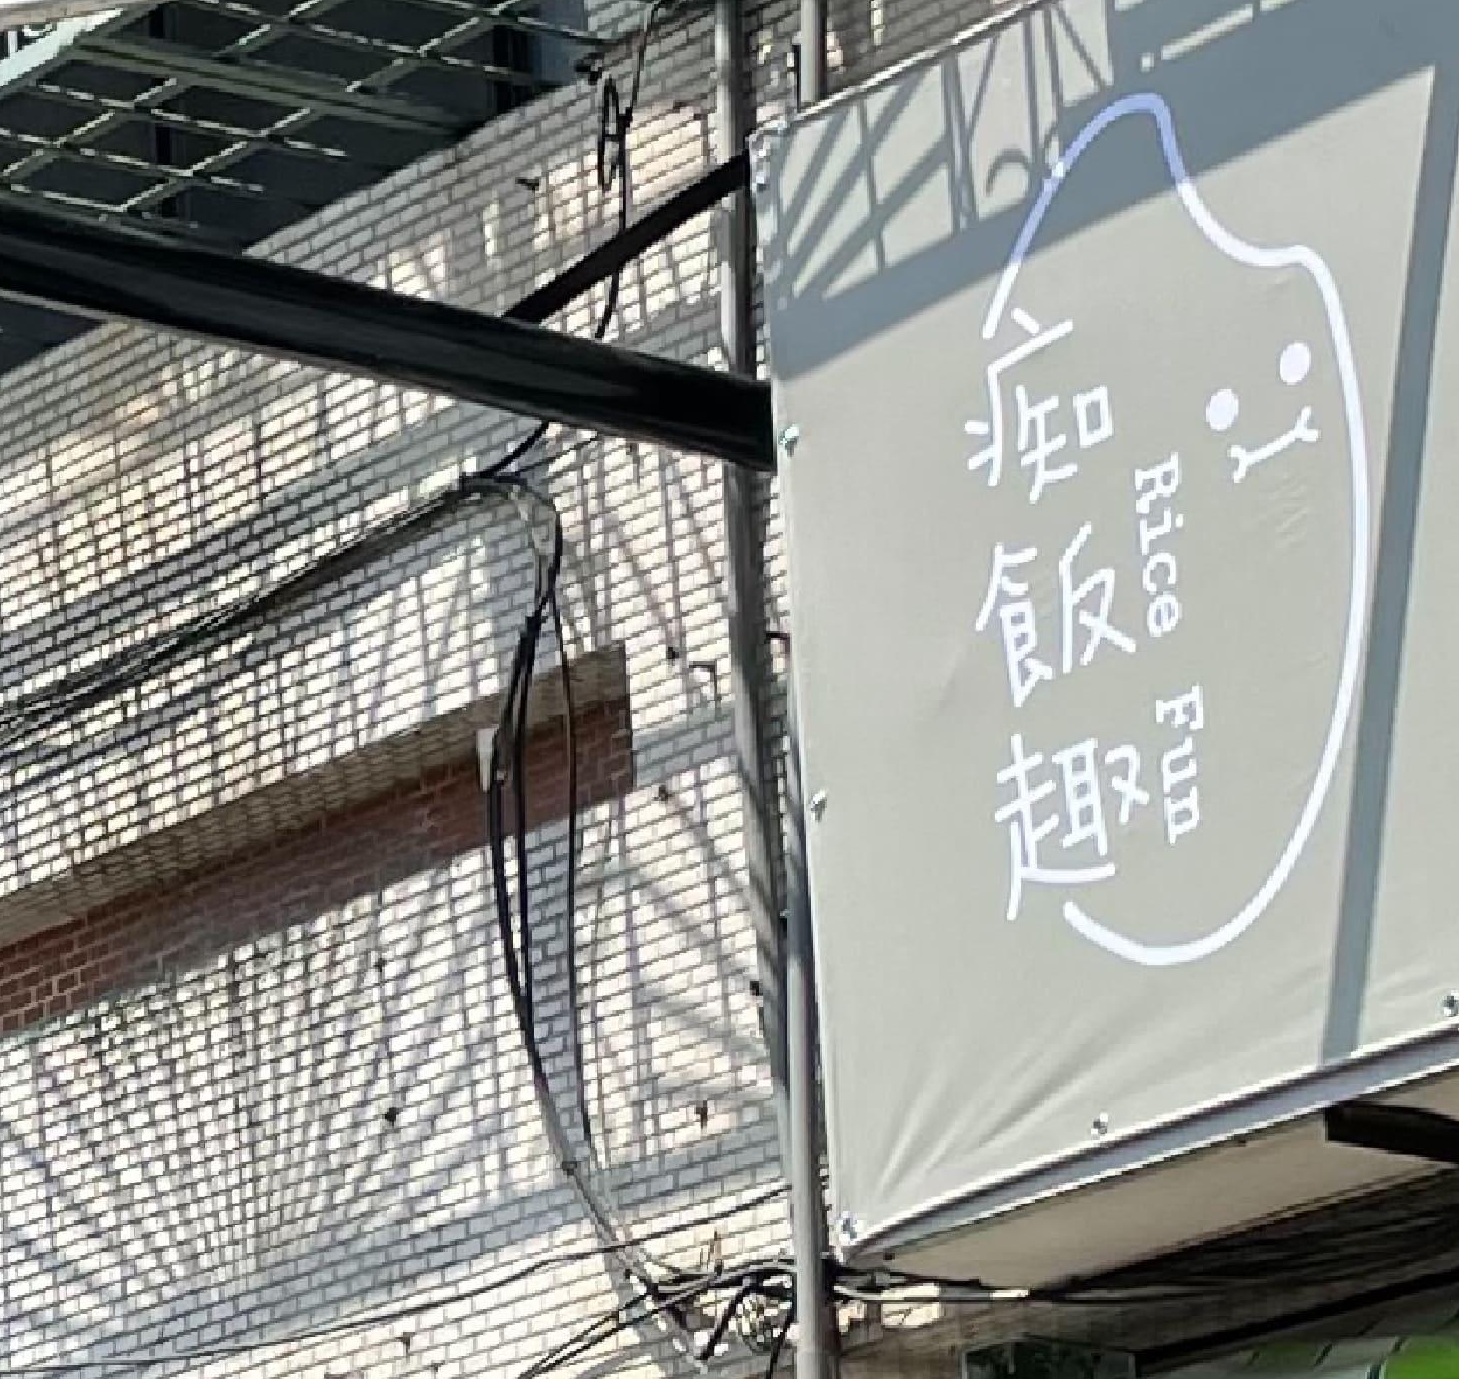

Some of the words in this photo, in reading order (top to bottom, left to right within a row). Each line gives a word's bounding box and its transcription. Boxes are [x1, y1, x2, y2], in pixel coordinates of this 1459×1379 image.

[963, 306, 1150, 921] 痴飯趣
[1133, 451, 1185, 639] Rice
[1155, 682, 1205, 846] Fun
